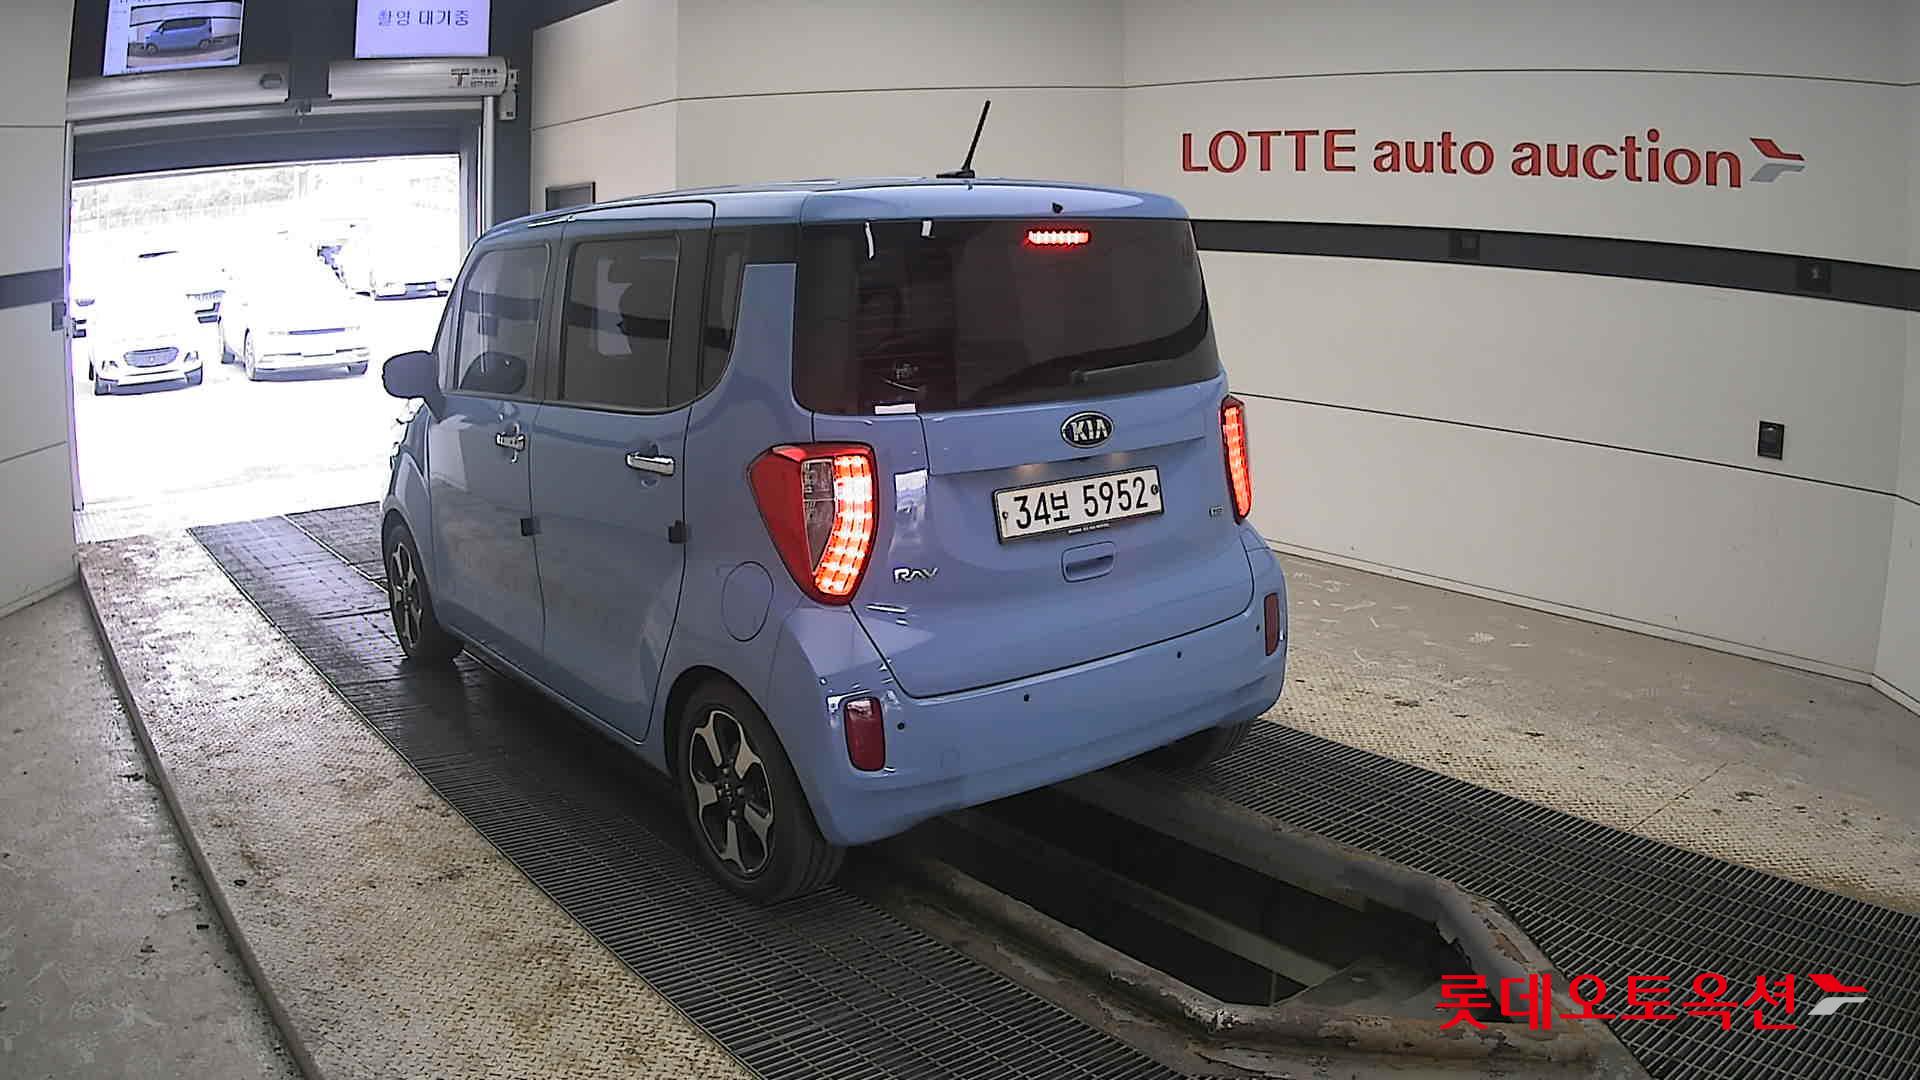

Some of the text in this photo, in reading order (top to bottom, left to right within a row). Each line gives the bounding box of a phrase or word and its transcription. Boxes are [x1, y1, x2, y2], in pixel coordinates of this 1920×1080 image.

[418, 9, 469, 26] 대기중
[1181, 128, 1742, 188] LOTTE auto auction
[1070, 418, 1109, 442] KIA
[1013, 476, 1149, 530] 34보 5952
